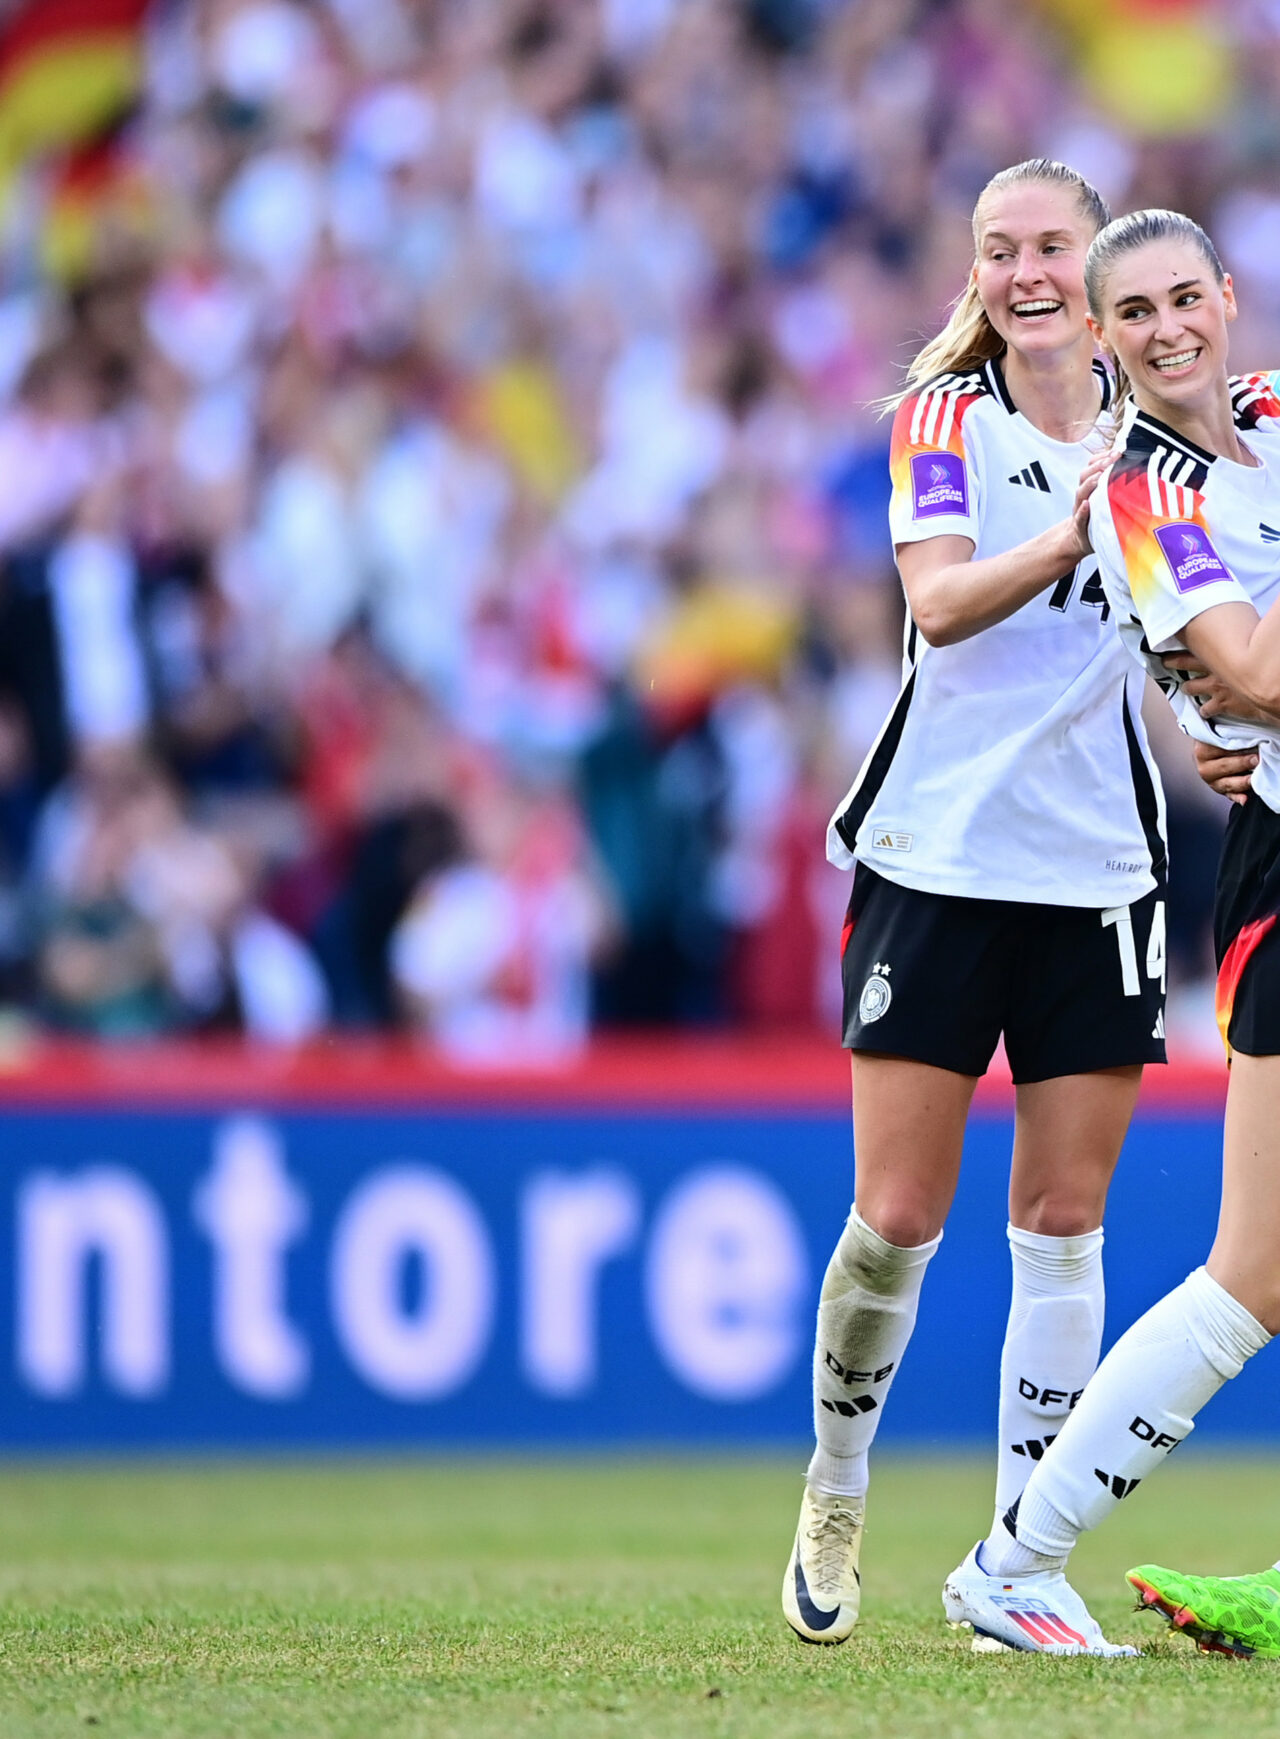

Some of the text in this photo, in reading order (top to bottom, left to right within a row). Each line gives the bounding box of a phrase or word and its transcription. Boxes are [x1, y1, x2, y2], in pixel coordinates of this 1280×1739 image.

[1101, 900, 1167, 997] 14
[16, 1112, 807, 1400] ntore
[826, 1350, 894, 1385] DFB
[1128, 1415, 1183, 1454] DF
